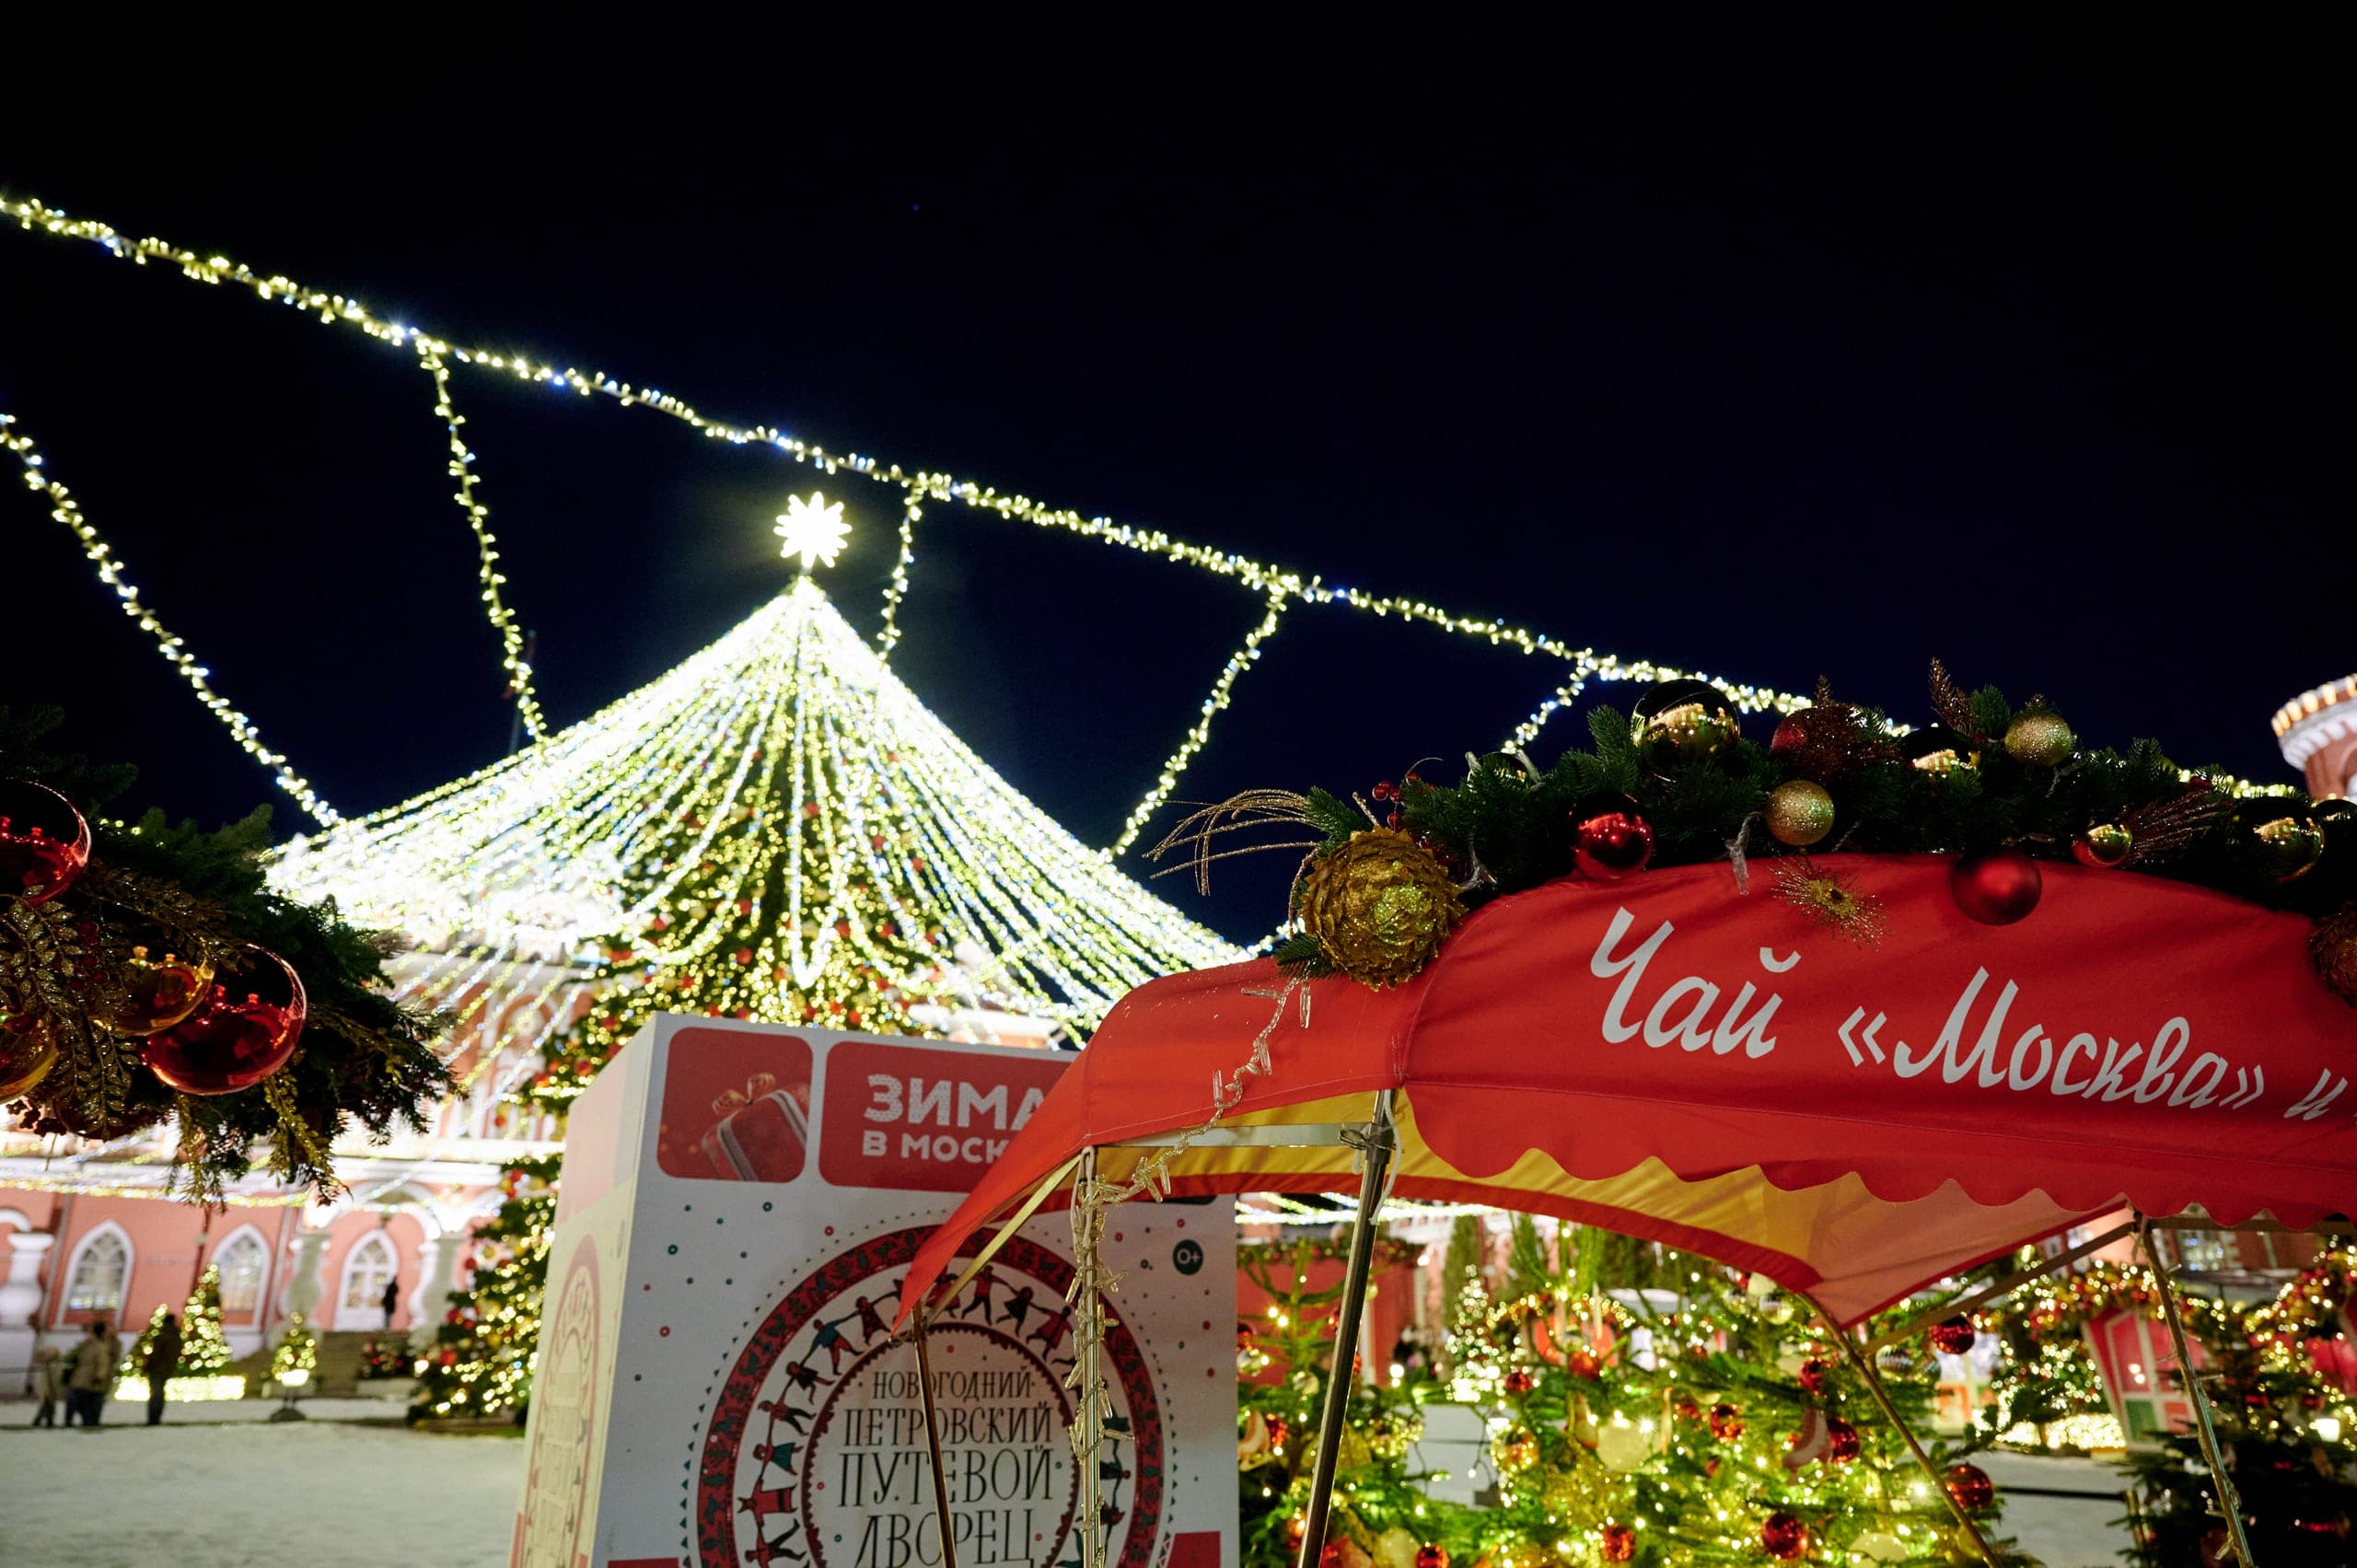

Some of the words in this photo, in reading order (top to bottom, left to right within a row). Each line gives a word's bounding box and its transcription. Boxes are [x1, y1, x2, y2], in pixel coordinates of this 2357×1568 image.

[1590, 906, 1802, 1059] Чай
[1838, 966, 2265, 1110] «Москва»
[2283, 1067, 2349, 1121] и
[862, 1130, 888, 1157] В
[900, 1132, 1010, 1165] МОСК
[873, 1365, 1032, 1402] НОВГОДНИЙ
